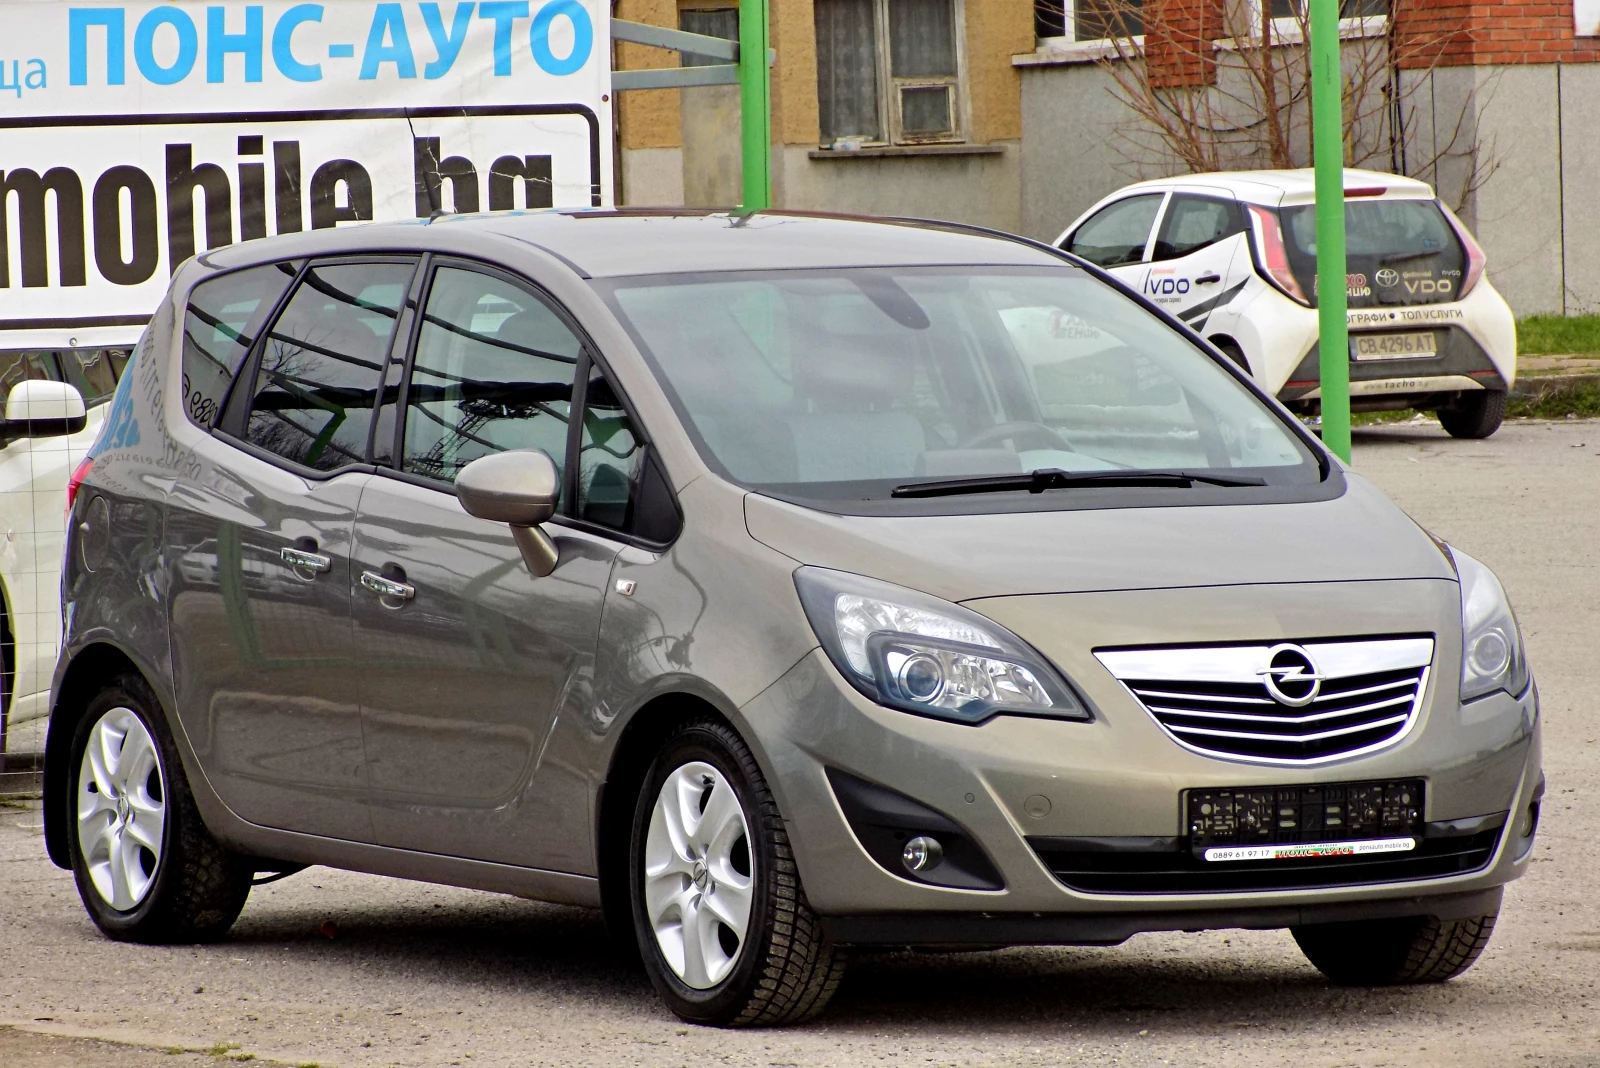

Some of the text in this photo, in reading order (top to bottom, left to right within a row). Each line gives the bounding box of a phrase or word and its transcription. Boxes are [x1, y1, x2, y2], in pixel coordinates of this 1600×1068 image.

[68, 0, 594, 86] ПОНС-АУТО
[1150, 278, 1190, 295] VDO
[1404, 279, 1452, 294] VDO
[1425, 309, 1463, 320] УСЛУГИ
[1380, 336, 1413, 354] 4296
[1213, 851, 1233, 859] 0889
[1261, 849, 1270, 857] 17
